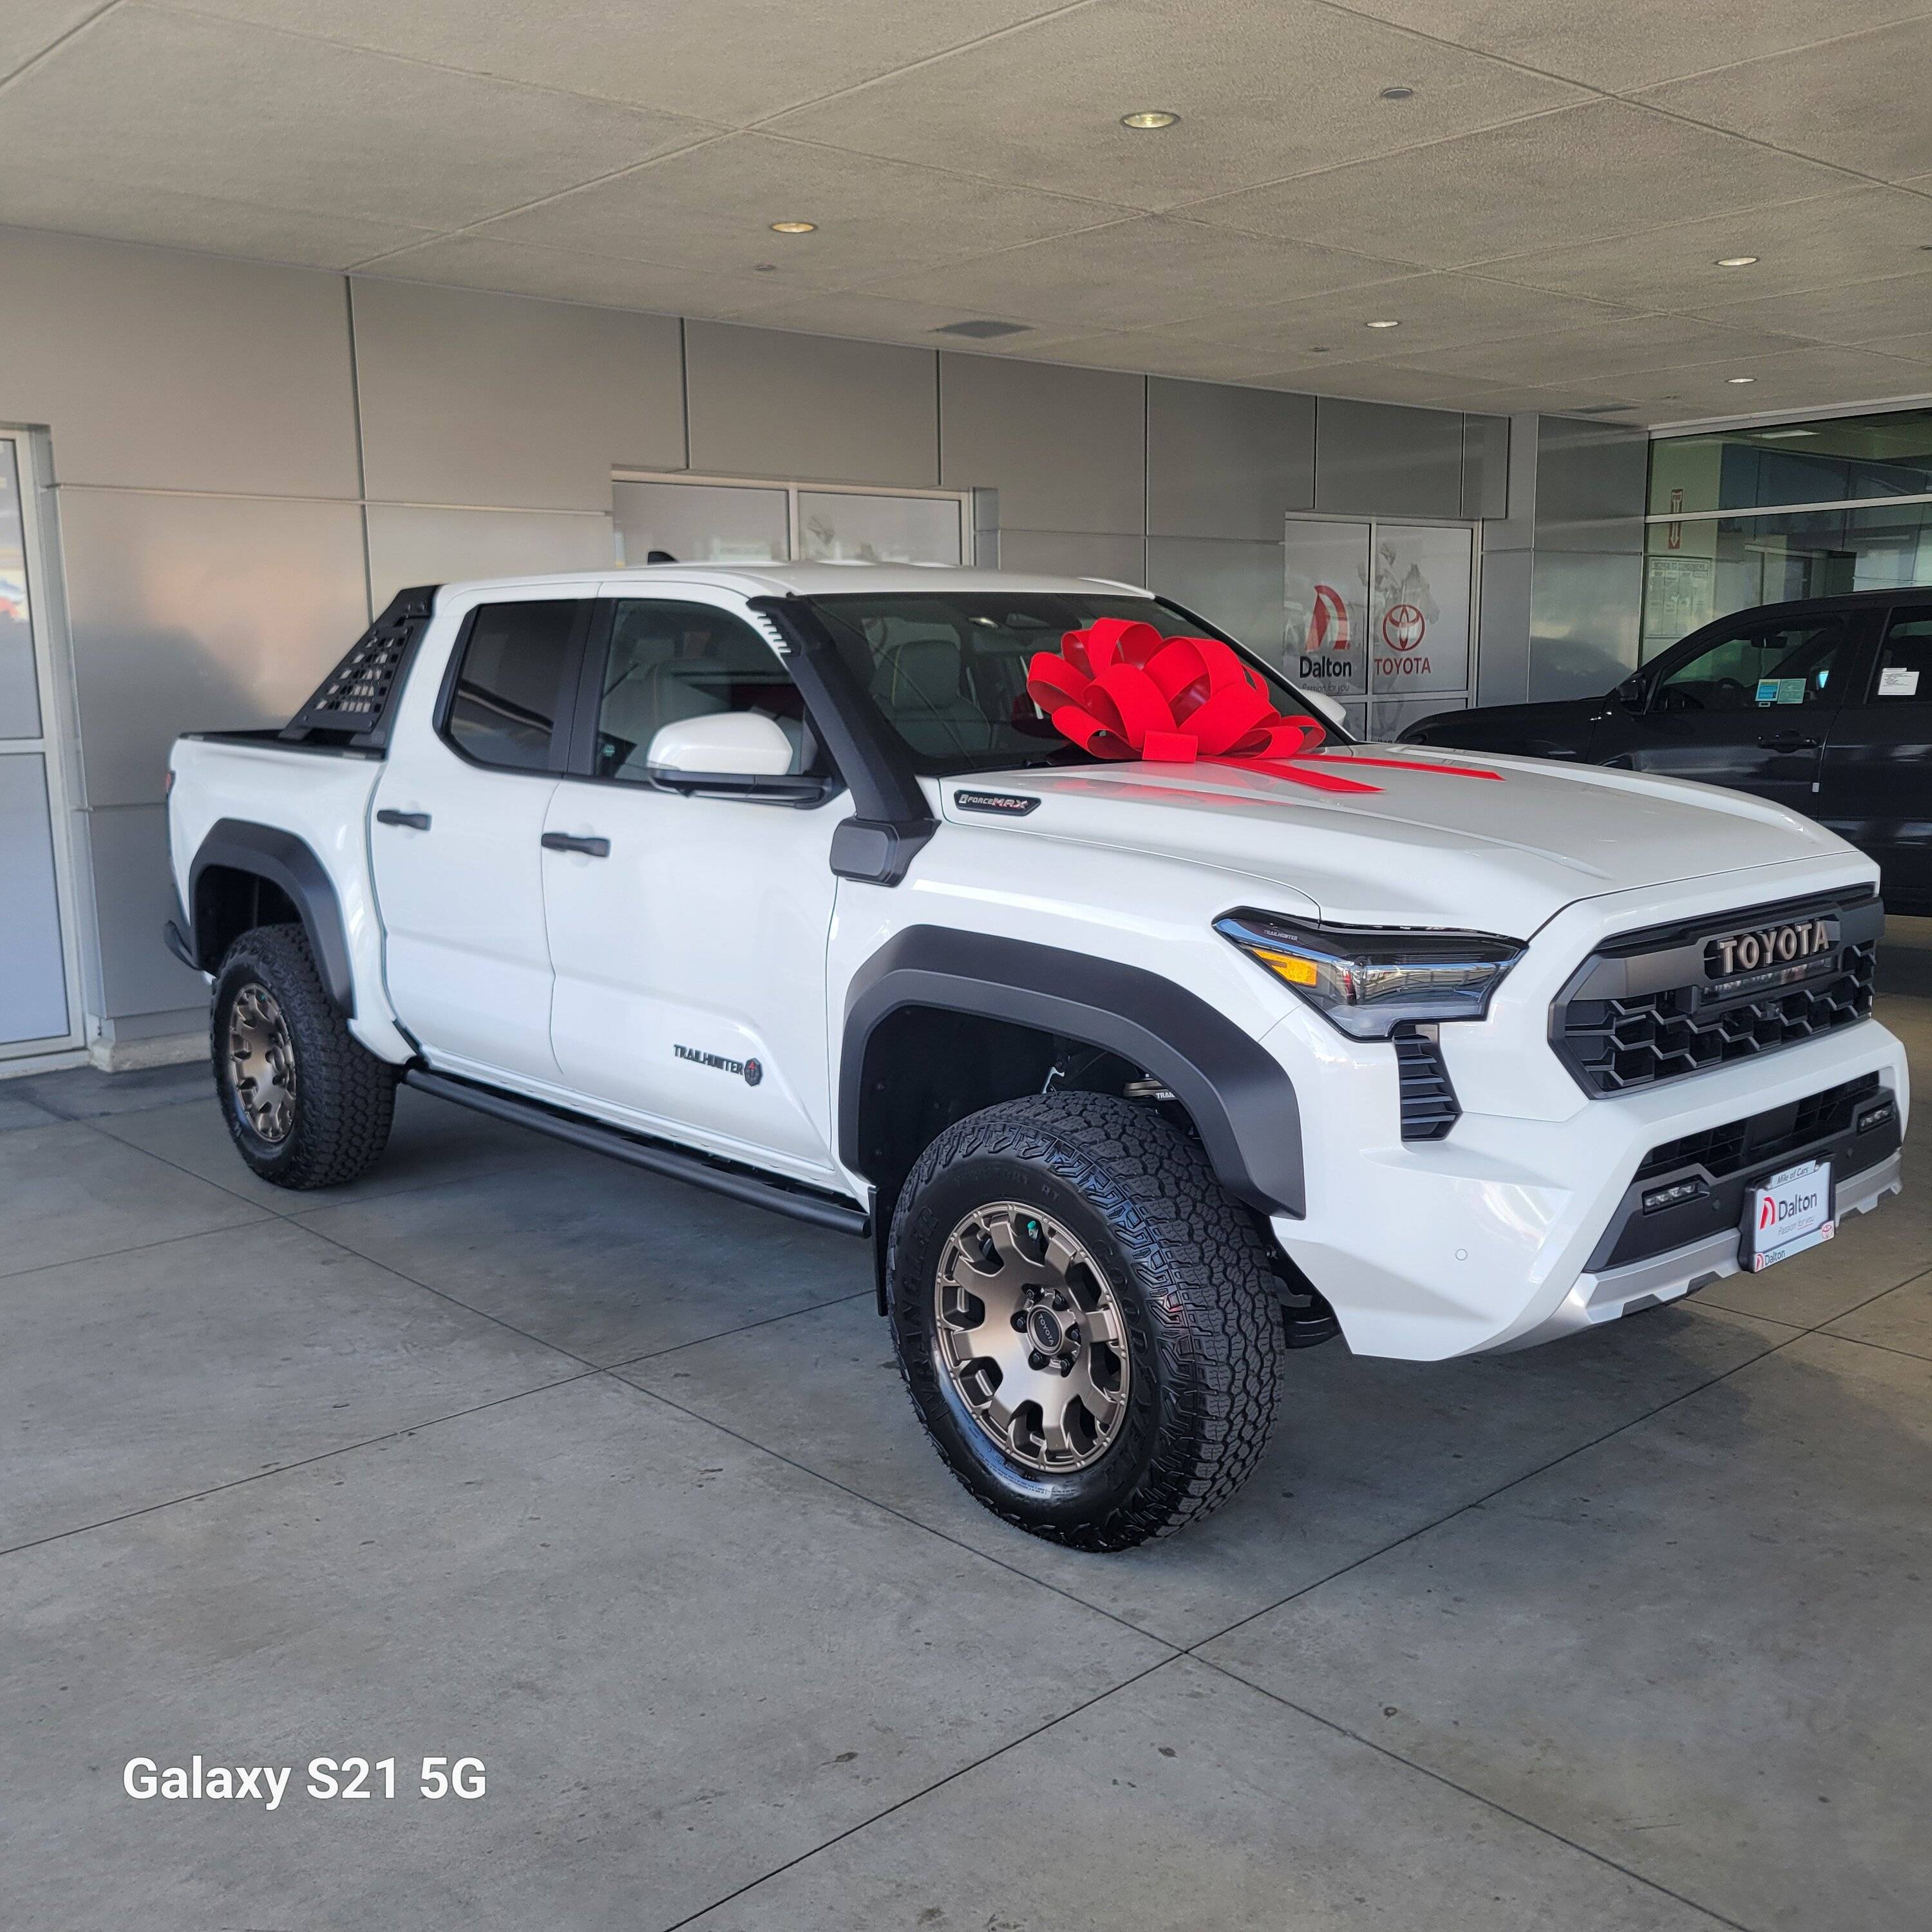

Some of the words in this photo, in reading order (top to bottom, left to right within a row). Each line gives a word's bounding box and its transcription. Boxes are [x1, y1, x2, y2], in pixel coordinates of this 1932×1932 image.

[1299, 656, 1352, 678] Dalton
[1374, 658, 1431, 675] TOYOTA
[1264, 929, 1298, 940] TRAILHUNTER
[1719, 920, 1829, 973] TOYOTA
[674, 1043, 744, 1075] TRAILHUNTER
[1777, 1174, 1789, 1184] Mile
[1790, 1169, 1796, 1179] of
[1797, 1167, 1809, 1176] Cars
[1778, 1193, 1817, 1222] Dalton
[1765, 1250, 1785, 1265] Dalton
[1039, 1314, 1054, 1345] TOYOTA
